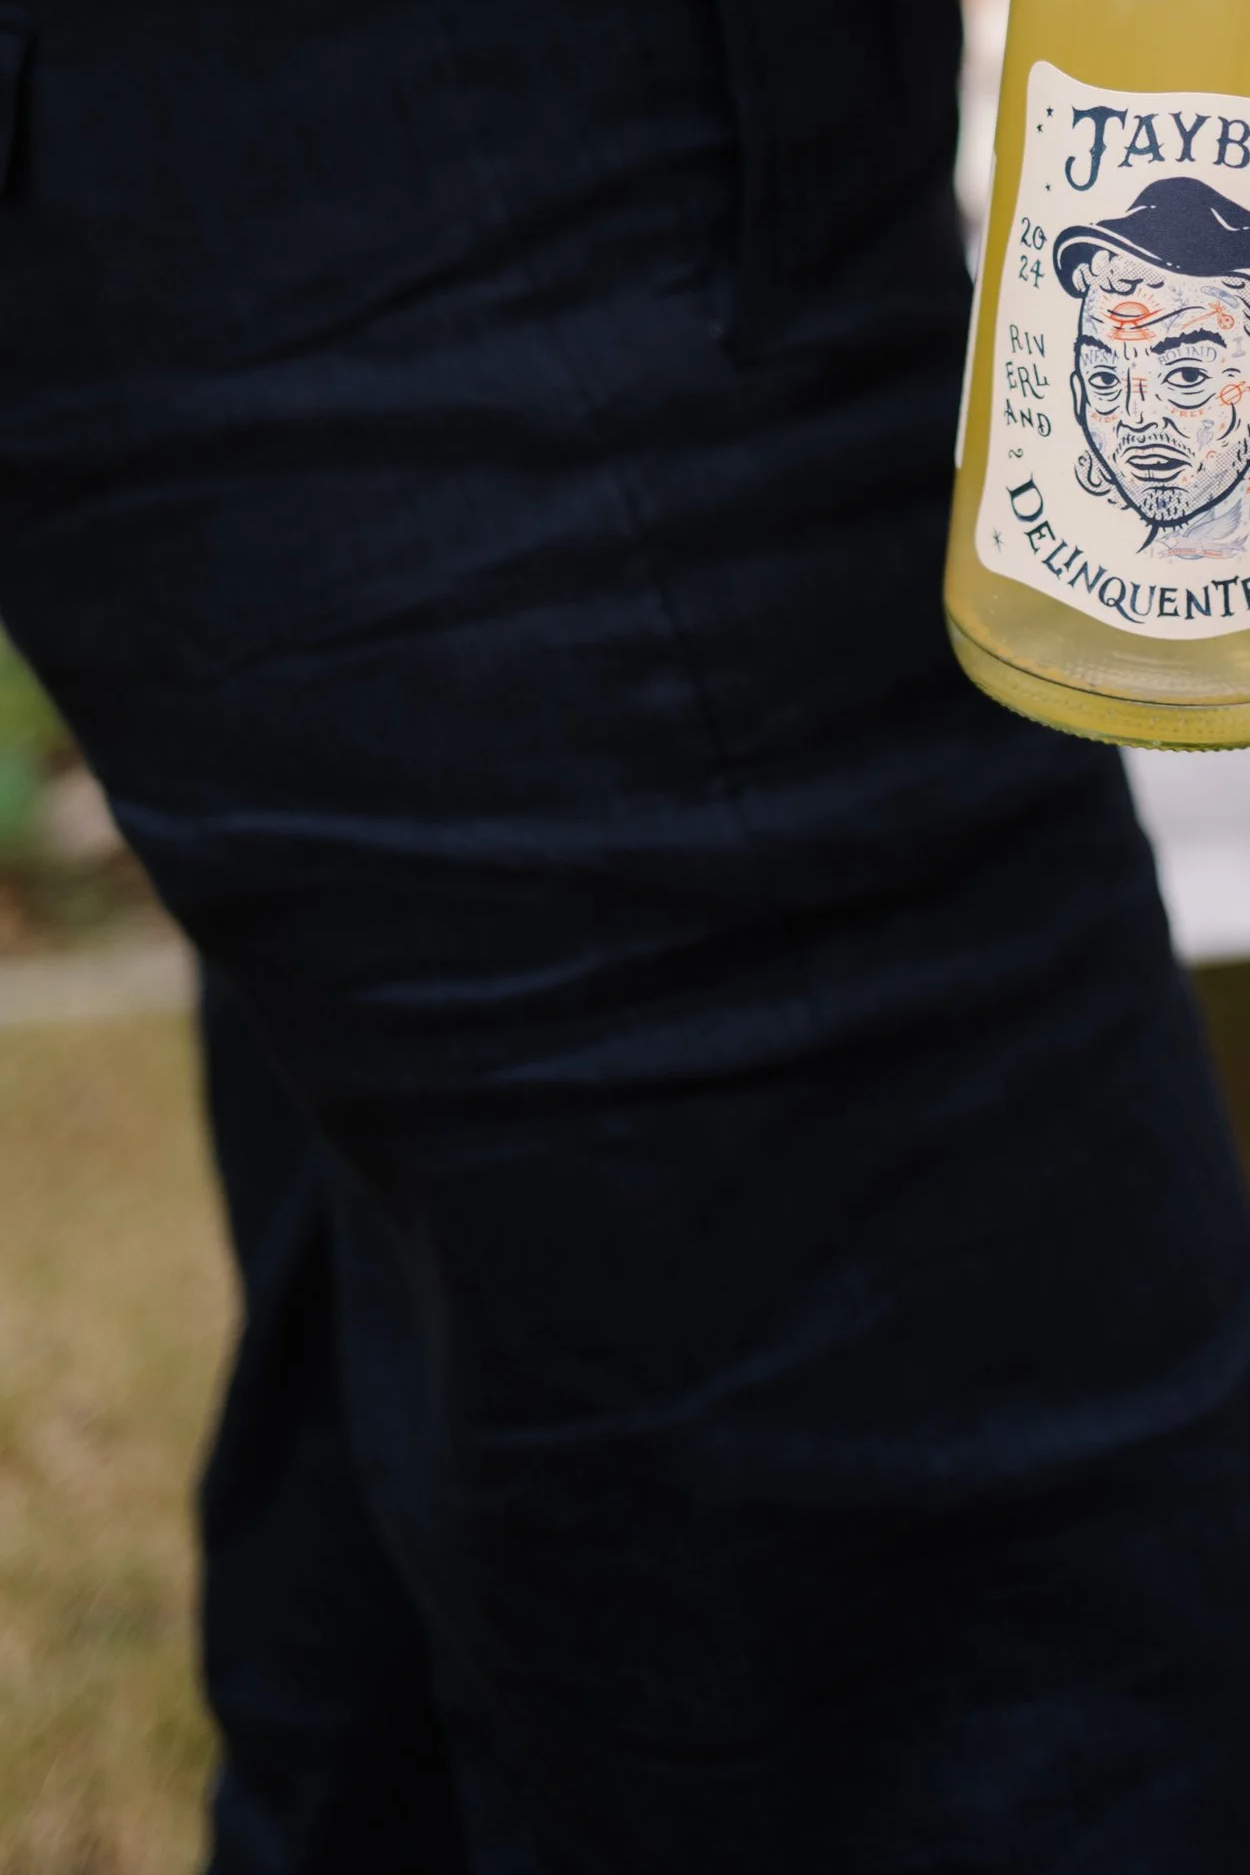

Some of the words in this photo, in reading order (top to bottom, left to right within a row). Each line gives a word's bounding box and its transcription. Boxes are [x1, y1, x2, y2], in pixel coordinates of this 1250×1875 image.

[1020, 217, 1047, 250] 20
[1019, 255, 1044, 288] 24
[1010, 324, 1046, 358] RIV
[1006, 361, 1050, 399] ERL
[1004, 398, 1051, 437] AND
